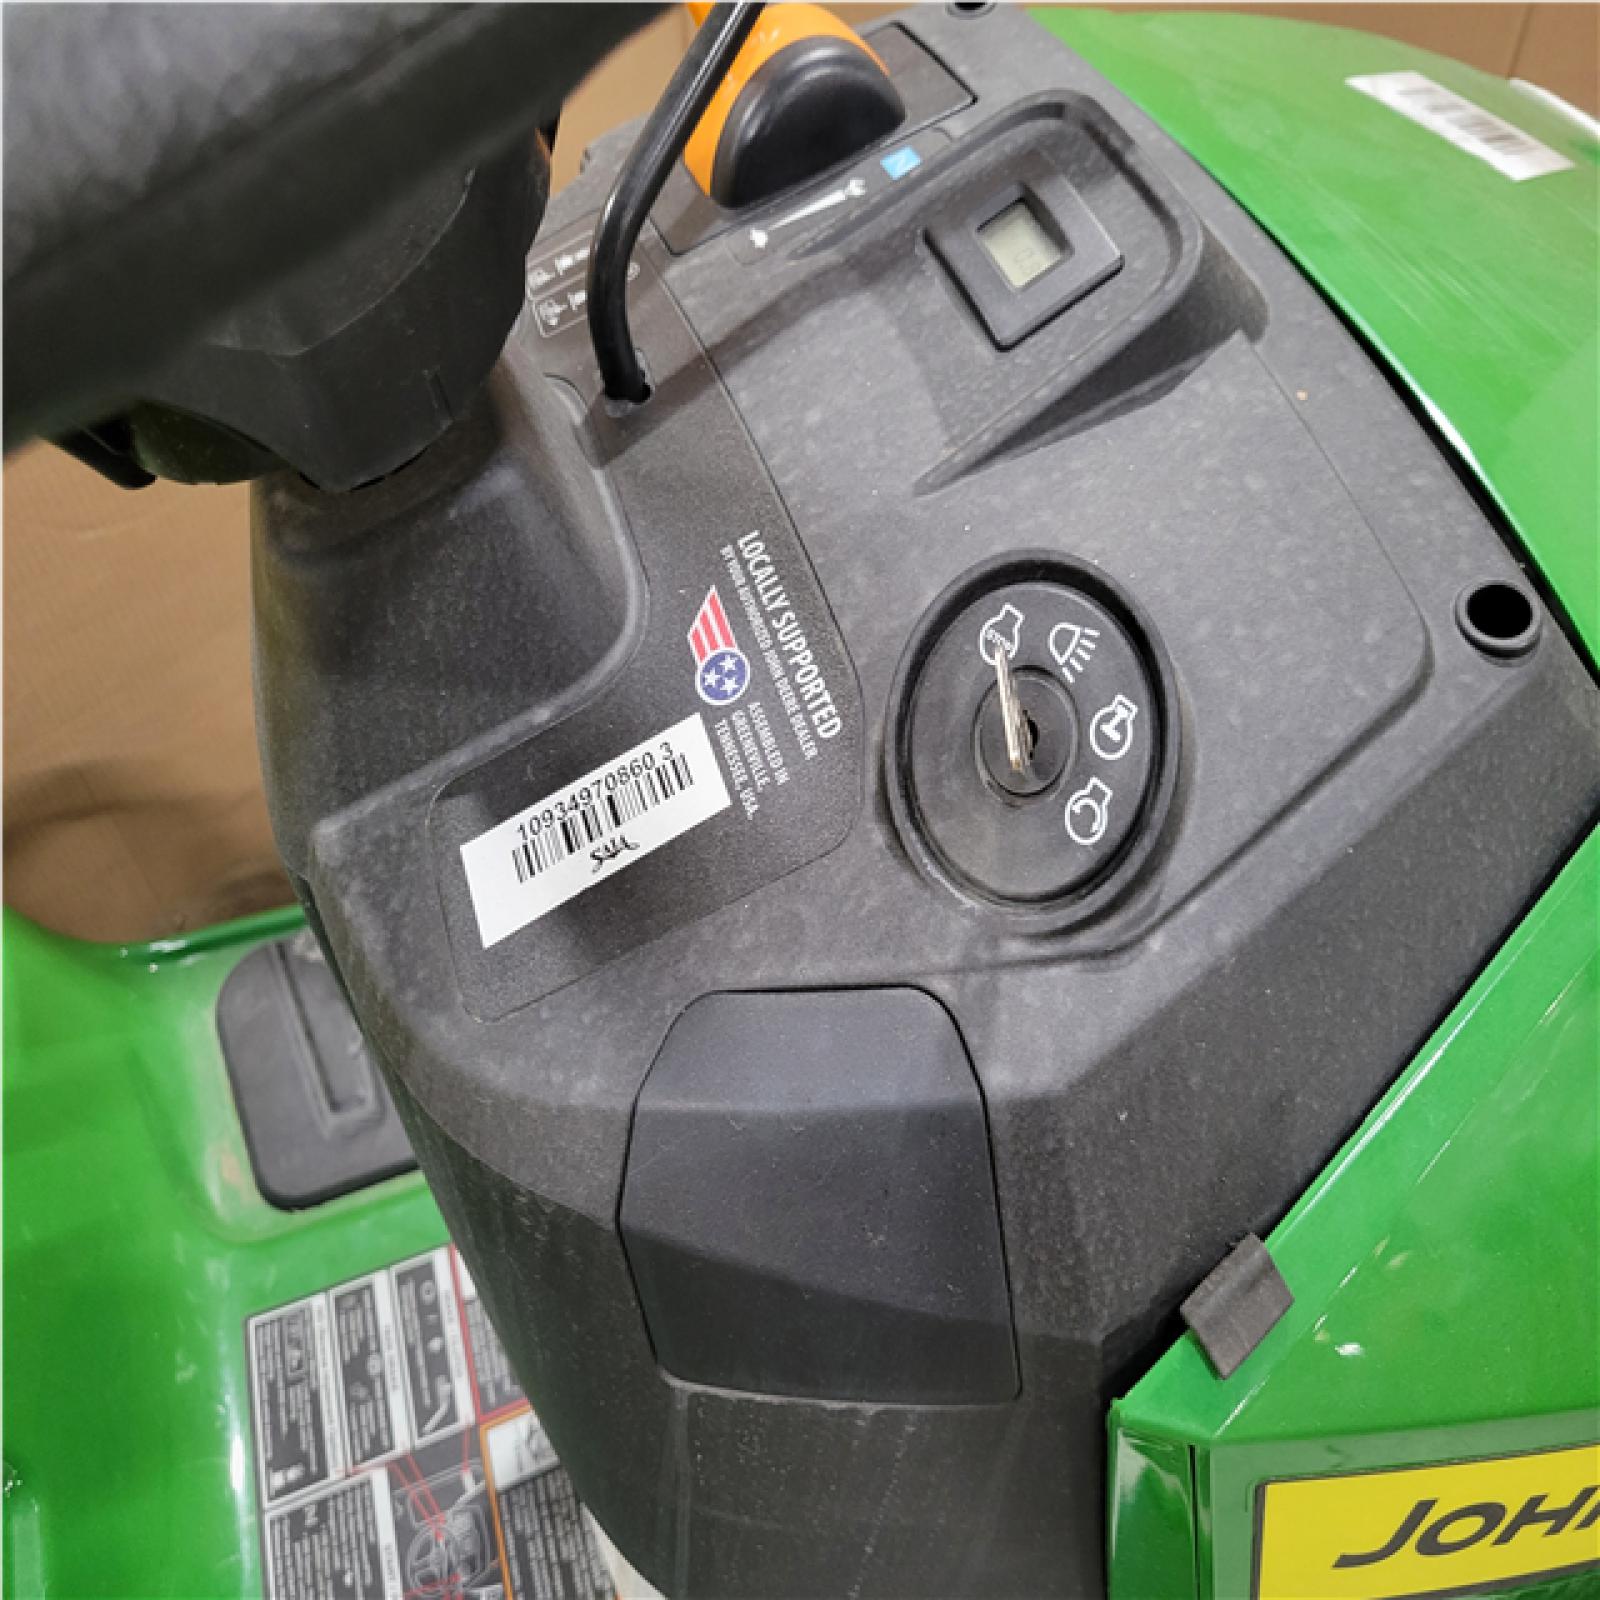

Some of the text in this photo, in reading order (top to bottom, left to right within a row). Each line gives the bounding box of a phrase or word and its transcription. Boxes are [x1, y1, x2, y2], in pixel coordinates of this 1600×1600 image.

[737, 530, 841, 739] LOCALLY SUPPORTED
[774, 677, 800, 716] DEERE
[659, 741, 674, 760] 3
[747, 702, 790, 786] ASSEMBLED IN
[1332, 1485, 1600, 1568] JOH
